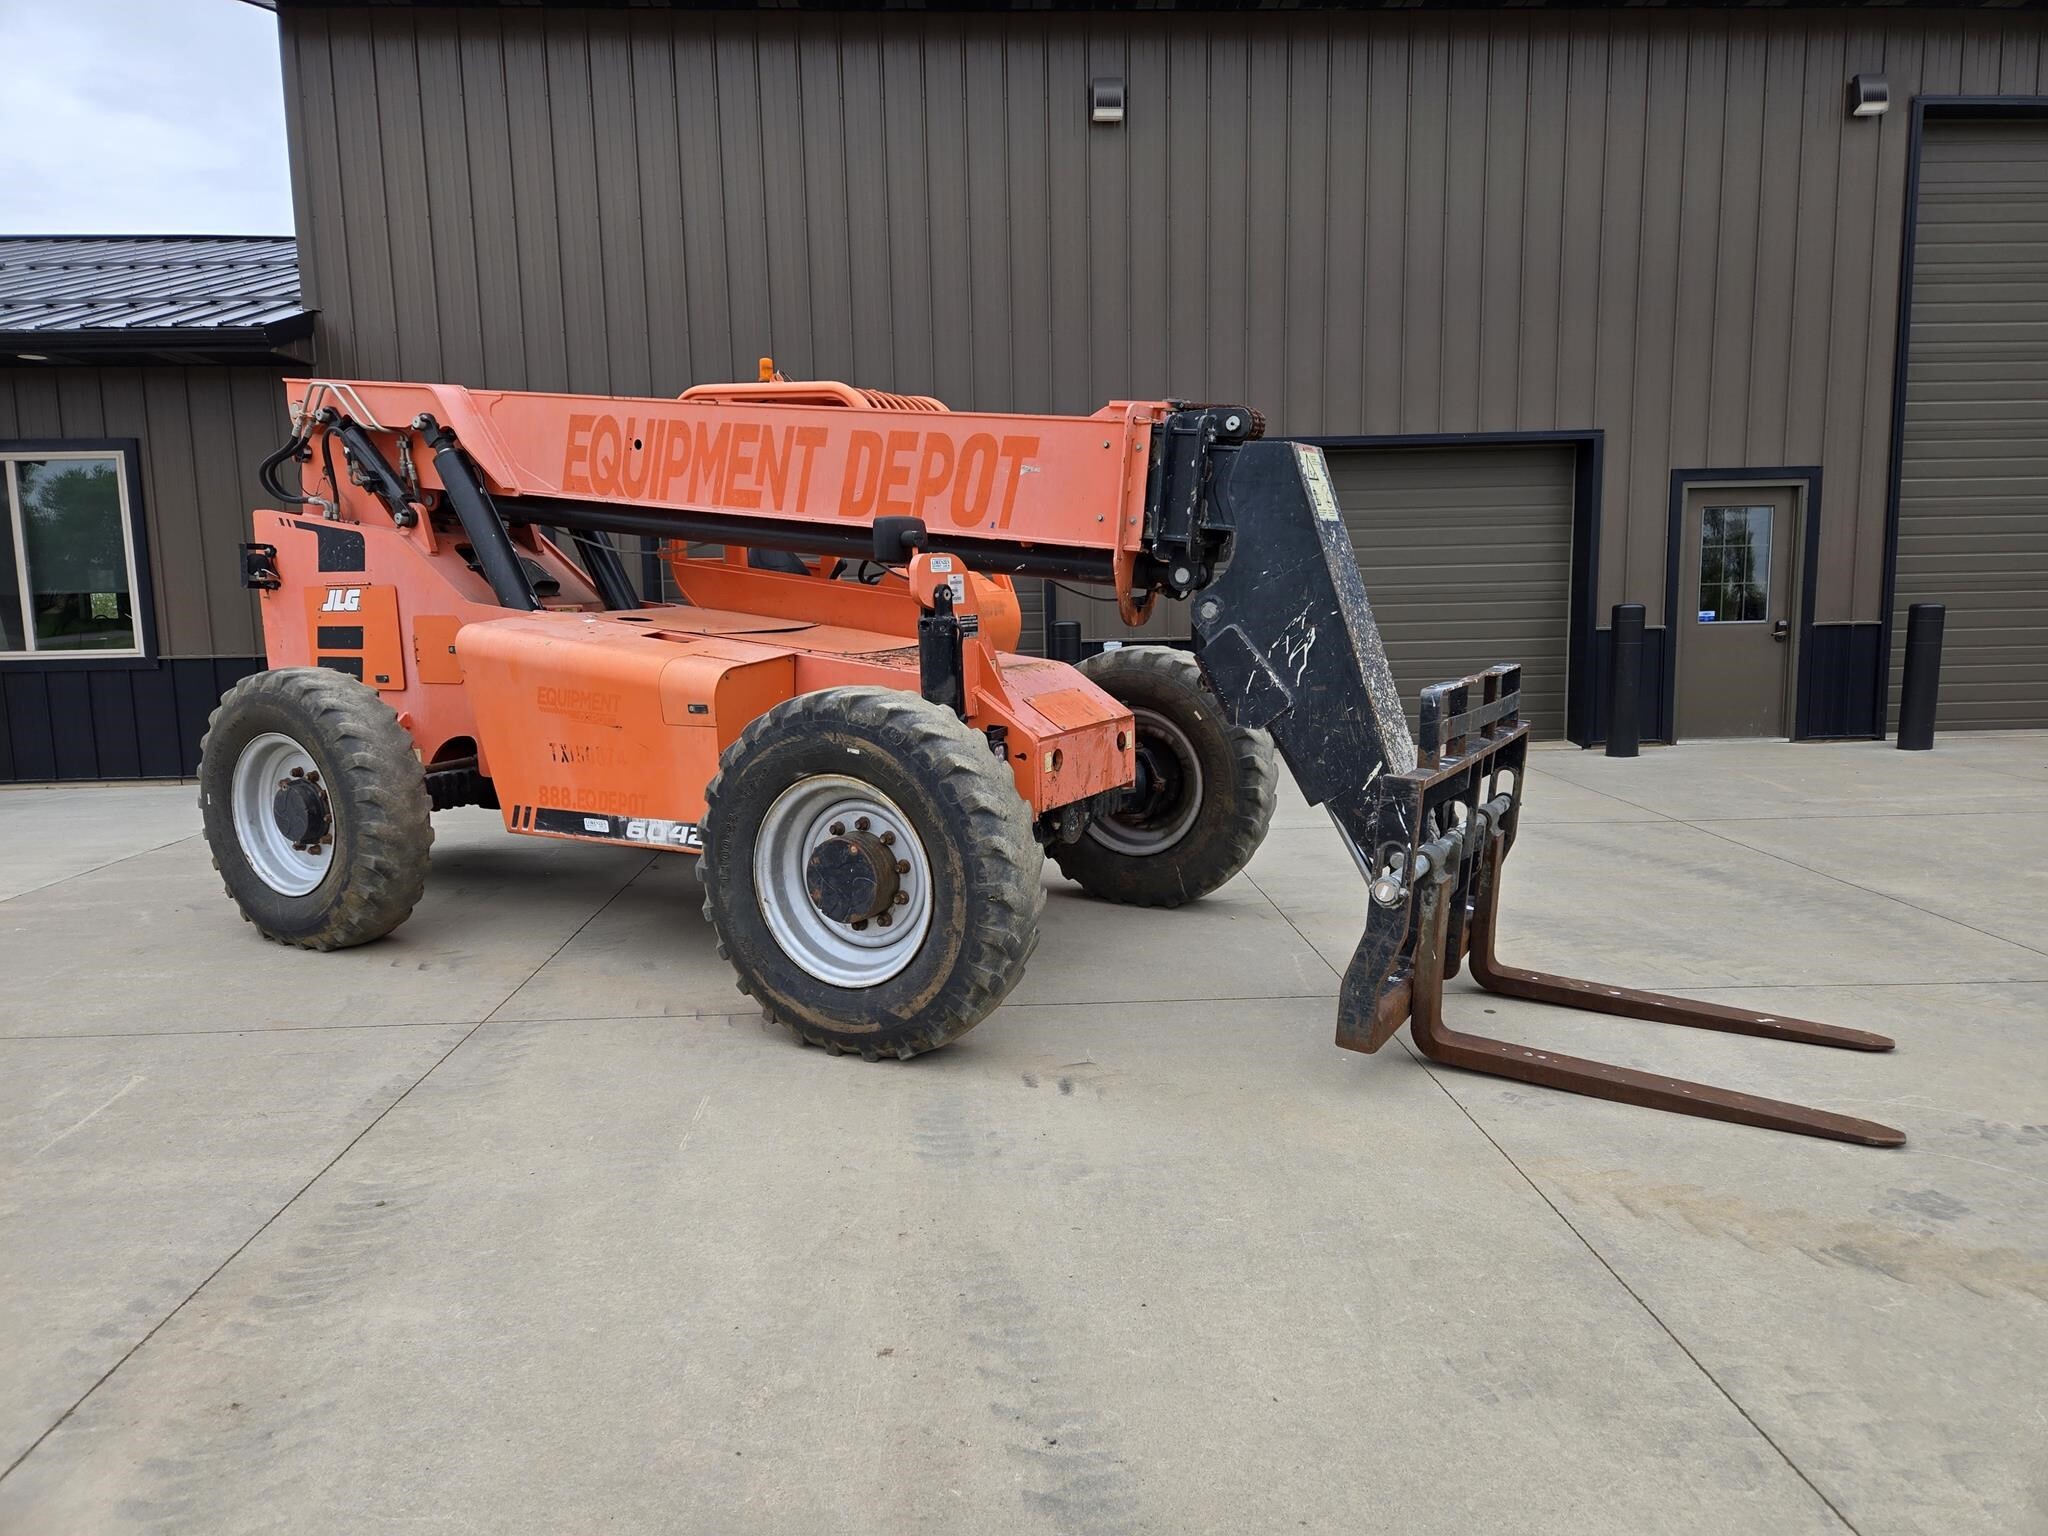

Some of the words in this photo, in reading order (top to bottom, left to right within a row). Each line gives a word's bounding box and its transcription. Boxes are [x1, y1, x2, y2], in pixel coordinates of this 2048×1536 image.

[562, 414, 828, 513] EQUIPMENT
[838, 430, 1040, 530] DEPOT
[321, 588, 361, 612] JLG
[537, 687, 621, 712] EQUIPMENT
[626, 821, 702, 846] 6042
